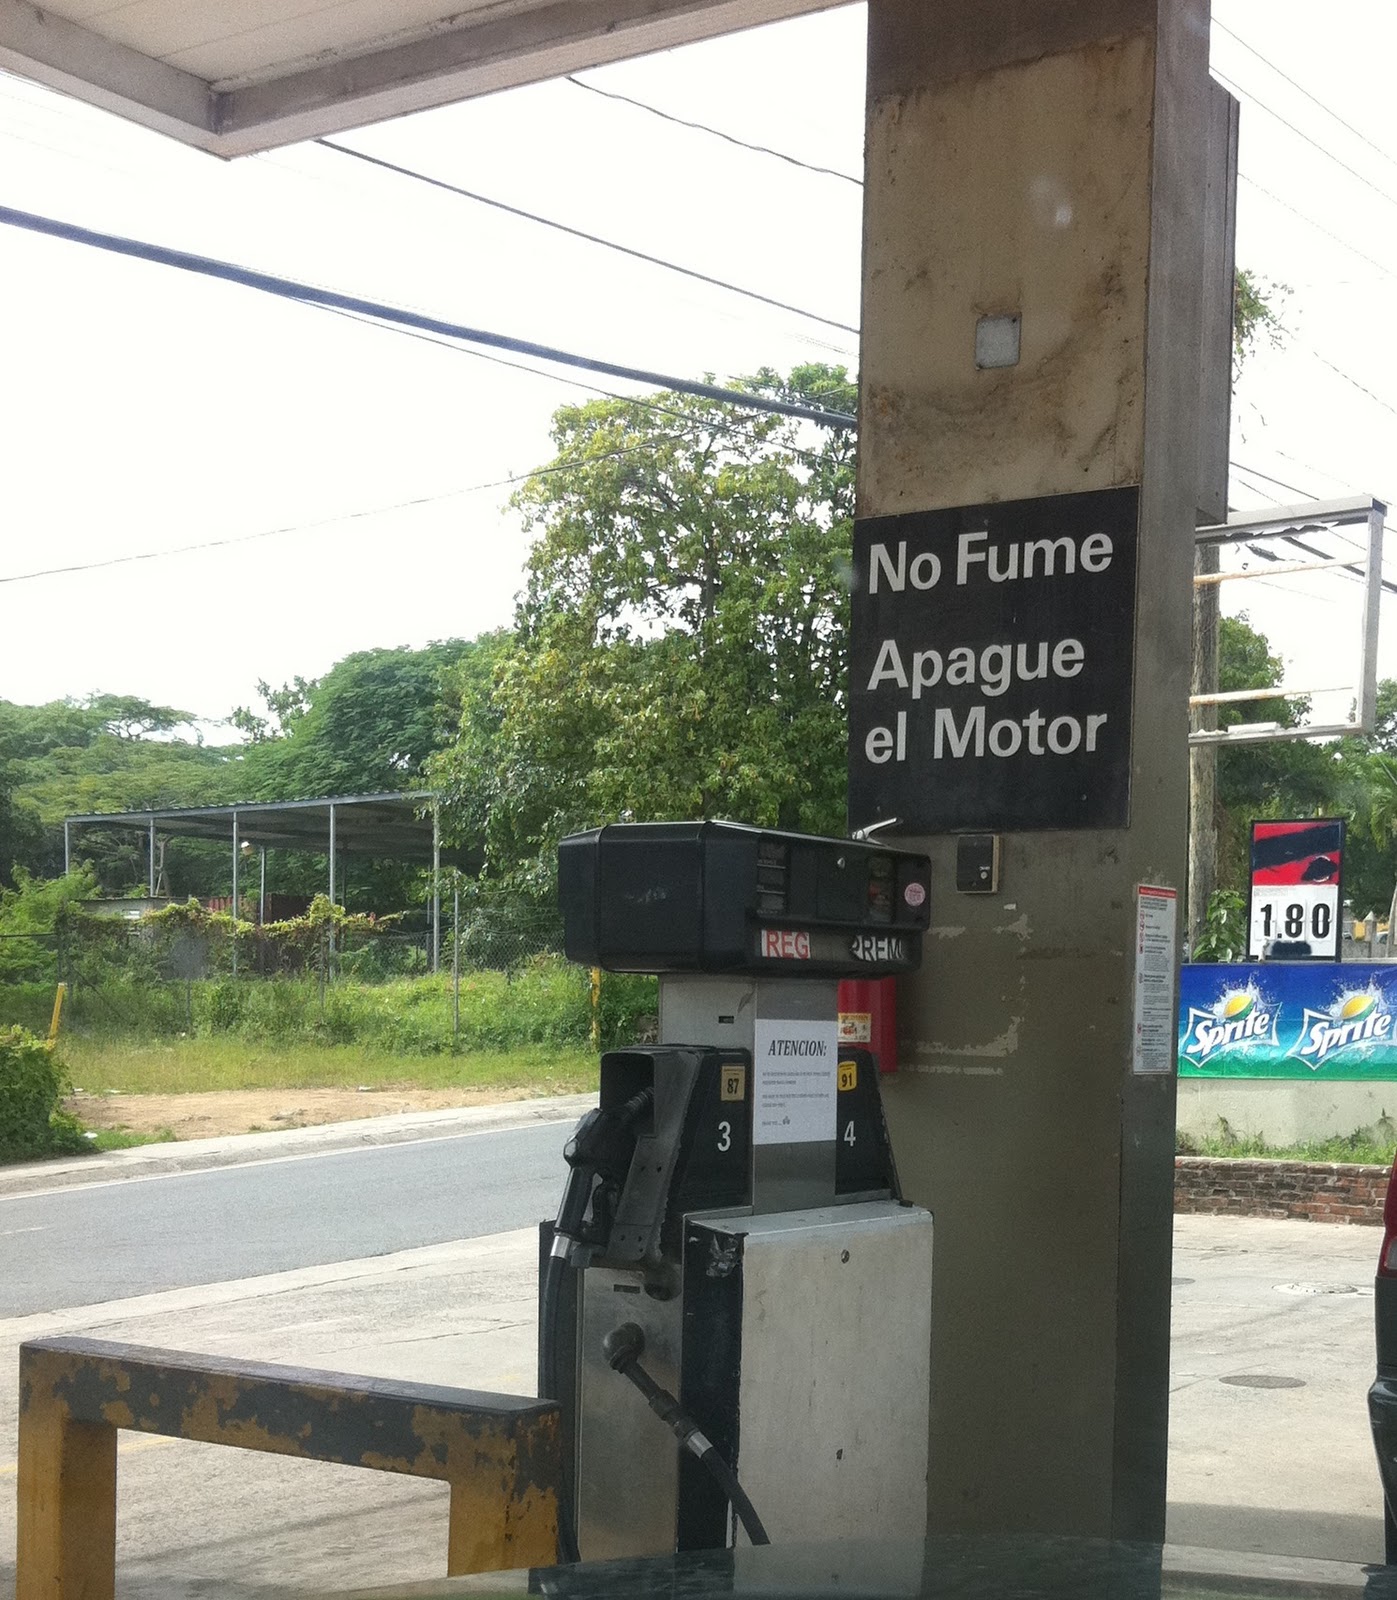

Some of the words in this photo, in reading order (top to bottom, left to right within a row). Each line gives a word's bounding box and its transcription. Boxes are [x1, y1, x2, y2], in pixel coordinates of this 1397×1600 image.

[869, 541, 941, 594] No
[957, 531, 1113, 585] Fume
[867, 638, 1084, 699] Apague
[865, 711, 907, 763] el
[933, 706, 1107, 759] Motor
[1260, 903, 1331, 939] 1.80
[766, 930, 810, 960] REG
[768, 1040, 828, 1057] ATENCION:
[1187, 1008, 1269, 1056] Sprite
[1300, 1007, 1392, 1058] Sprite
[727, 1078, 740, 1095] 87
[841, 1073, 853, 1088] 91
[717, 1121, 731, 1152] 3
[843, 1120, 856, 1147] 4
